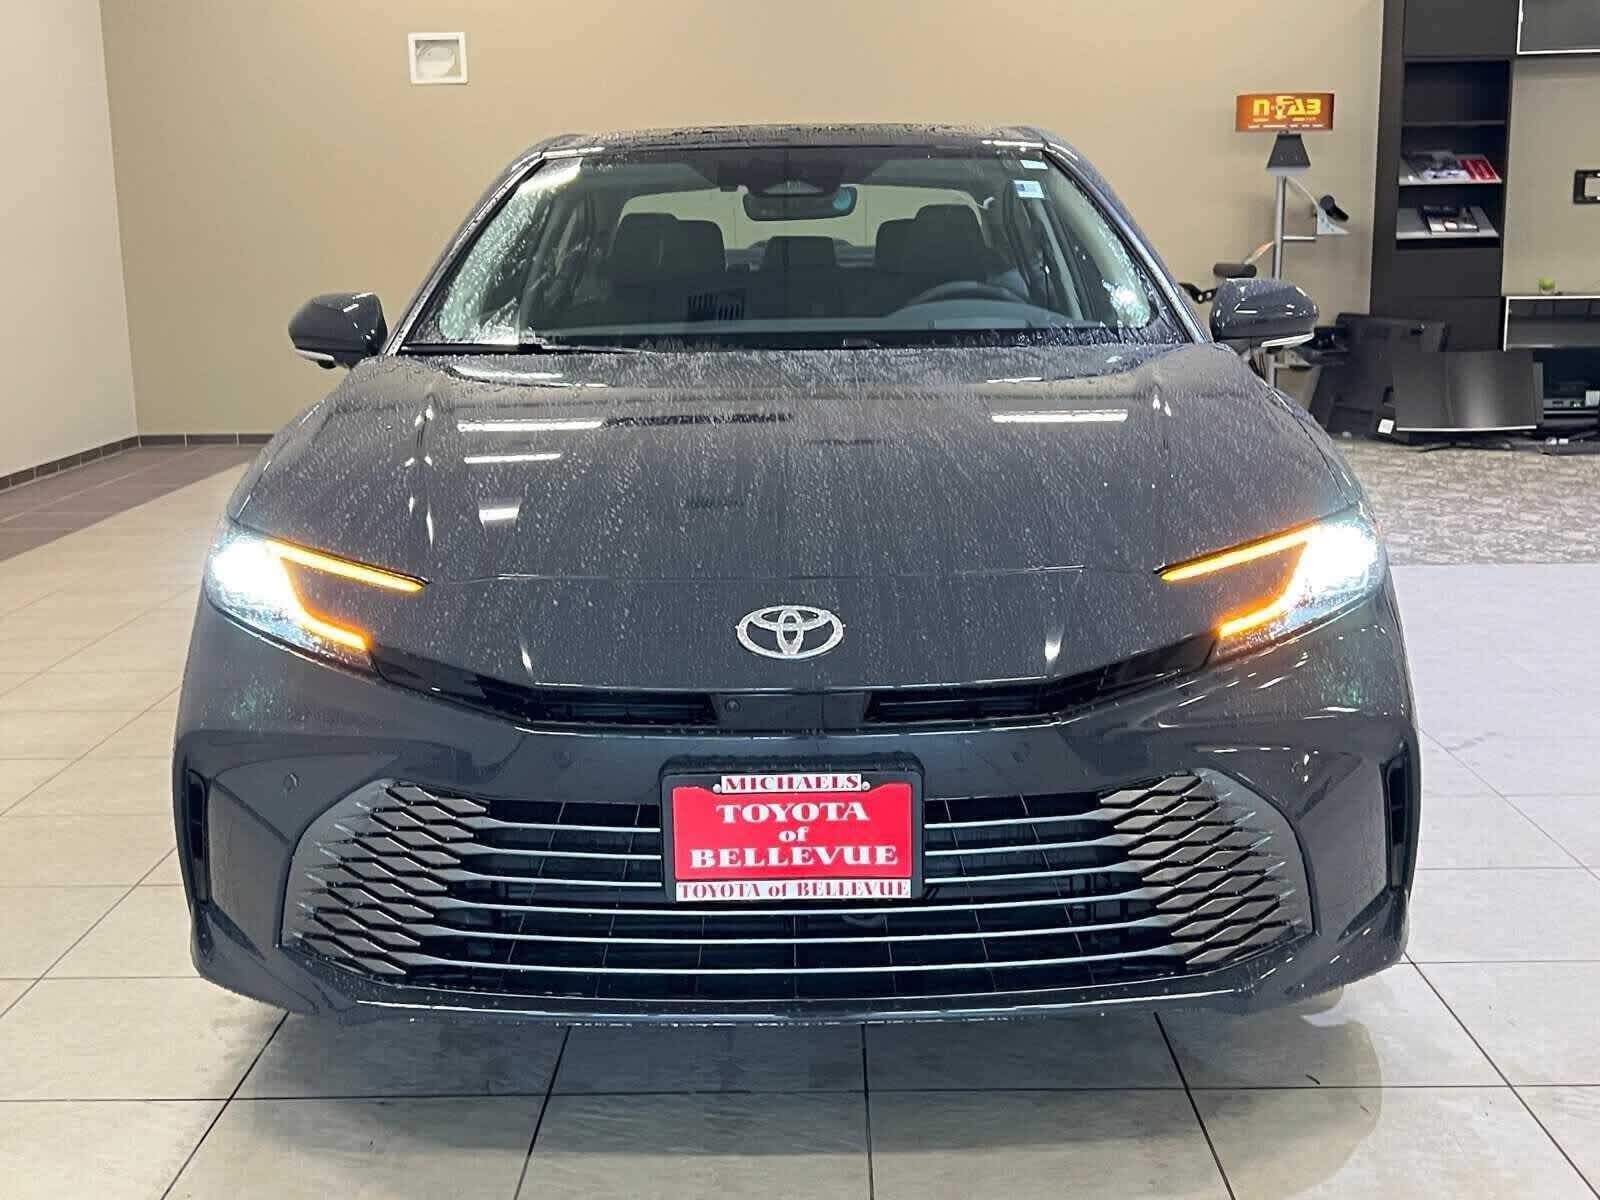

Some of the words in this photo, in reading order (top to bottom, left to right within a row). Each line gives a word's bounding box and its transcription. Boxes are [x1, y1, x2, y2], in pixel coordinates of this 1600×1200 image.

[725, 775, 859, 790] MICHAELS
[716, 802, 869, 823] TOYOTA
[778, 826, 808, 842] of
[690, 846, 898, 868] BELLEVUE
[679, 883, 760, 898] TOYOTA
[768, 883, 788, 897] of
[796, 881, 908, 897] BELLEVUE
